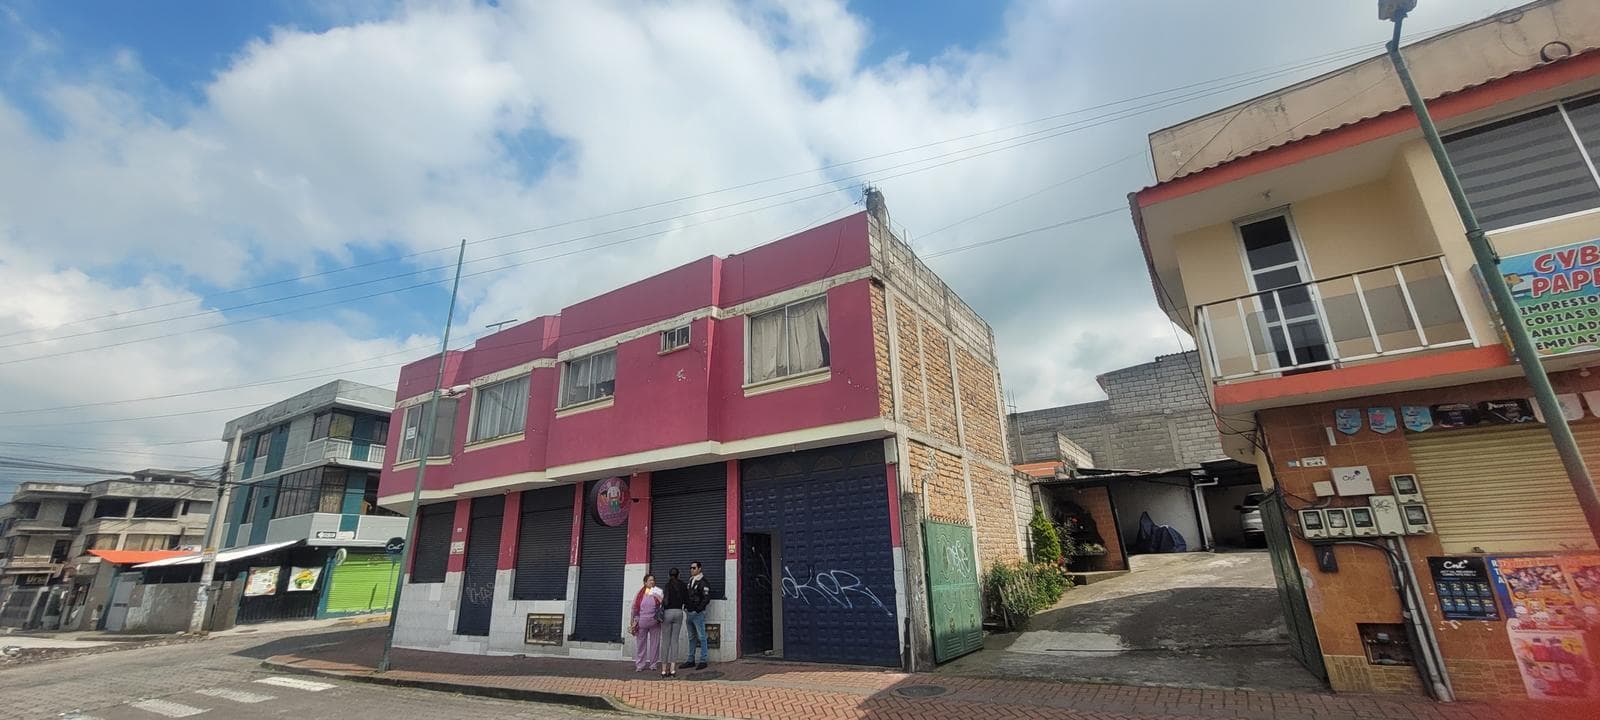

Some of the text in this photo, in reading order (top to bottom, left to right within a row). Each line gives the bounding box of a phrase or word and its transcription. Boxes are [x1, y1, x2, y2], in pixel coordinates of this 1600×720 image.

[1520, 295, 1600, 315] IMPRESIO
[1525, 310, 1585, 326] COPIAS
[1532, 320, 1600, 338] ANILLAD
